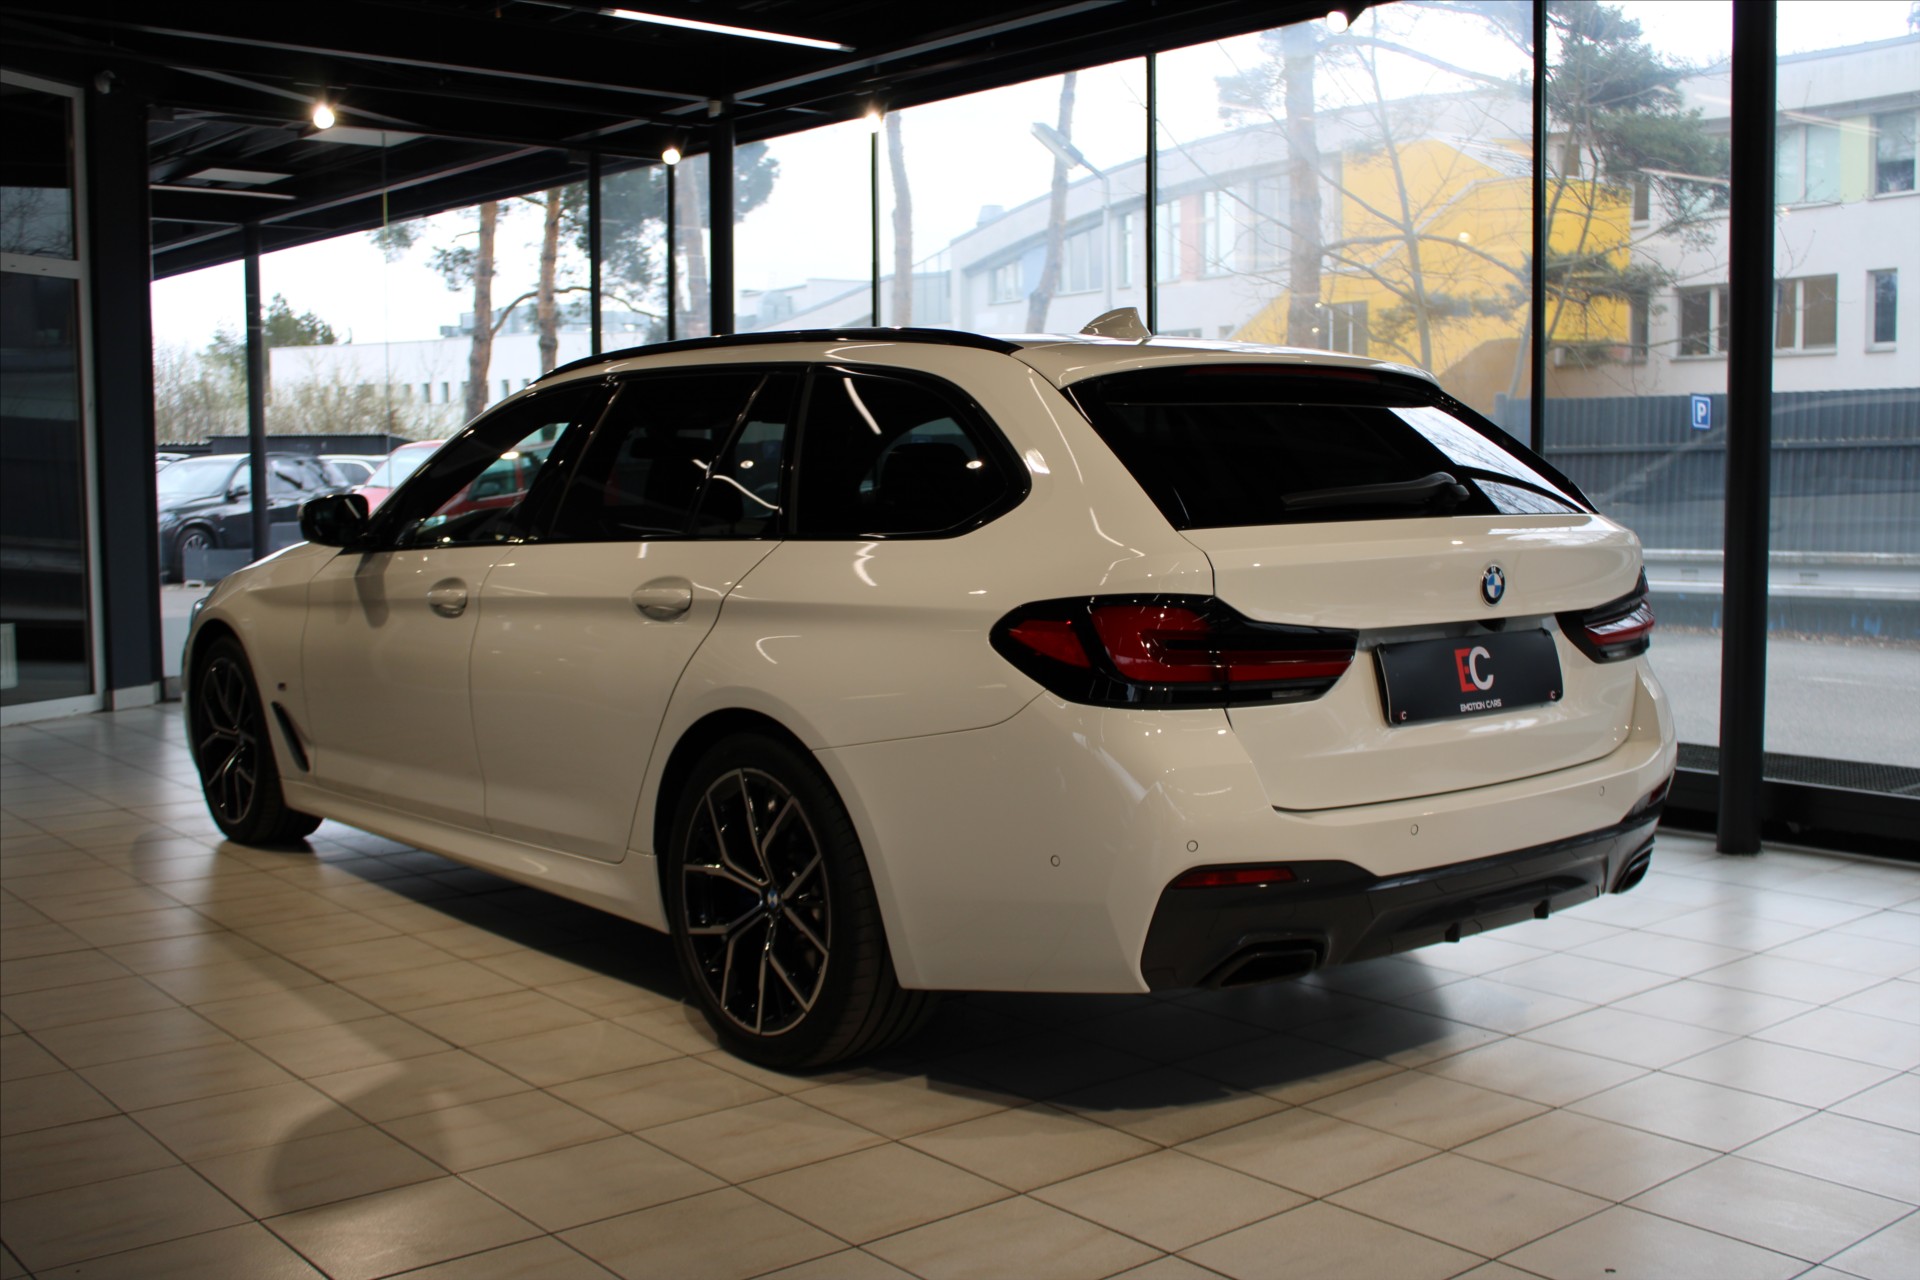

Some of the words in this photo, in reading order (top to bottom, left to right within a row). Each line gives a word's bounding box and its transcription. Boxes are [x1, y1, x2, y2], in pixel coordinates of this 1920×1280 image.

[1697, 402, 1707, 423] P
[1454, 646, 1494, 692] EC
[1460, 700, 1486, 713] EMOTION
[1486, 698, 1502, 709] CARS
